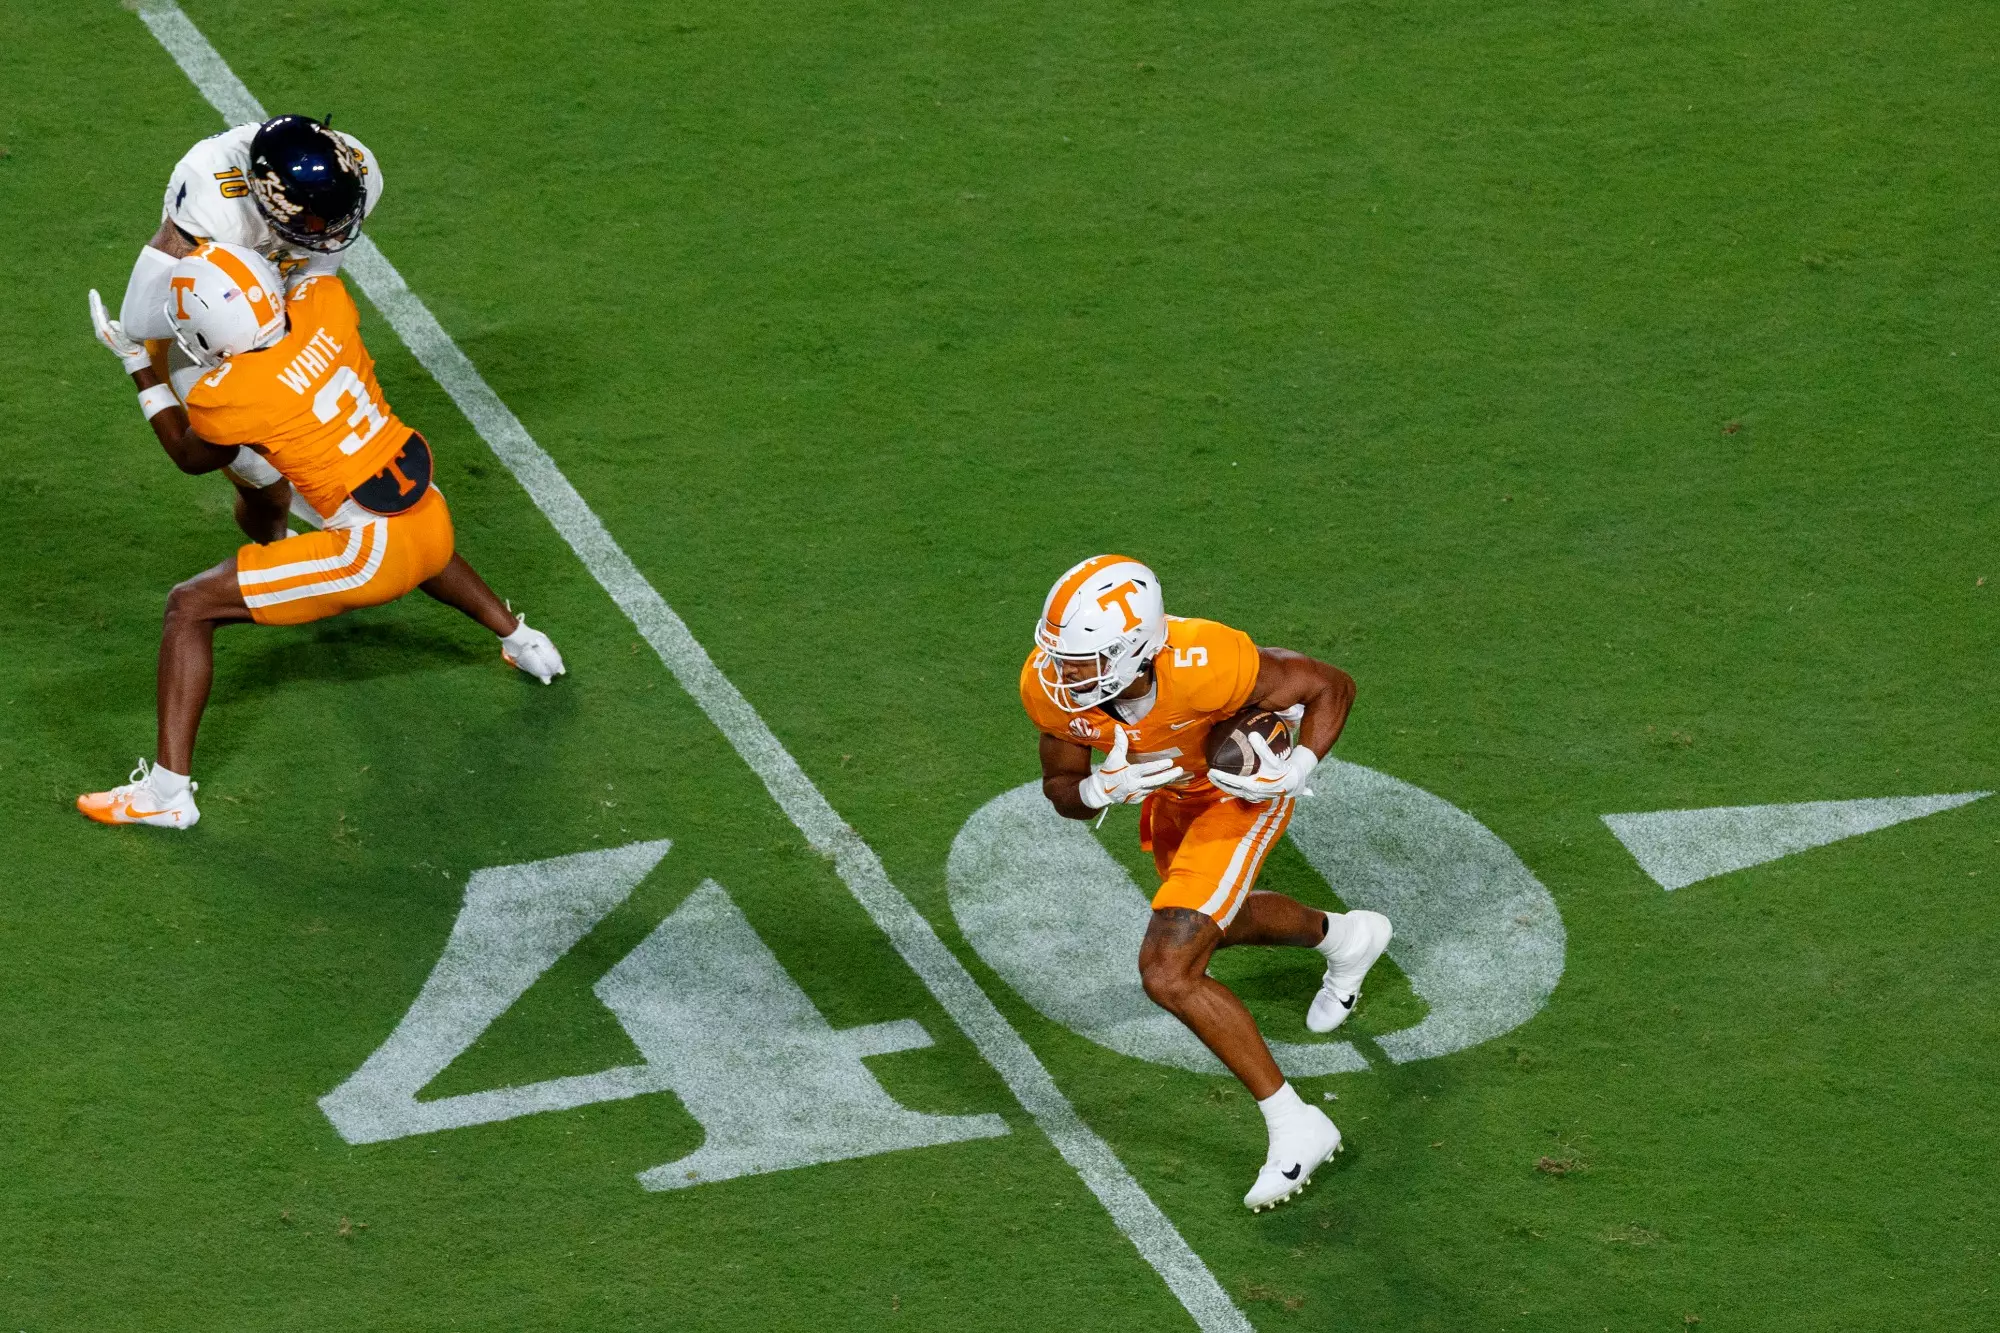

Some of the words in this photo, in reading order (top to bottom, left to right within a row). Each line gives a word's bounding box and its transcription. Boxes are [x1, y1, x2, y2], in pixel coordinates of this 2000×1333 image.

[213, 166, 250, 198] 10
[260, 171, 304, 215] Kent
[170, 276, 196, 320] T
[204, 363, 233, 388] 3
[276, 327, 343, 395] WHITE
[312, 366, 388, 456] 3
[376, 449, 417, 496] T
[1096, 580, 1143, 633] T
[1174, 646, 1208, 668] 5
[171, 811, 182, 822] T
